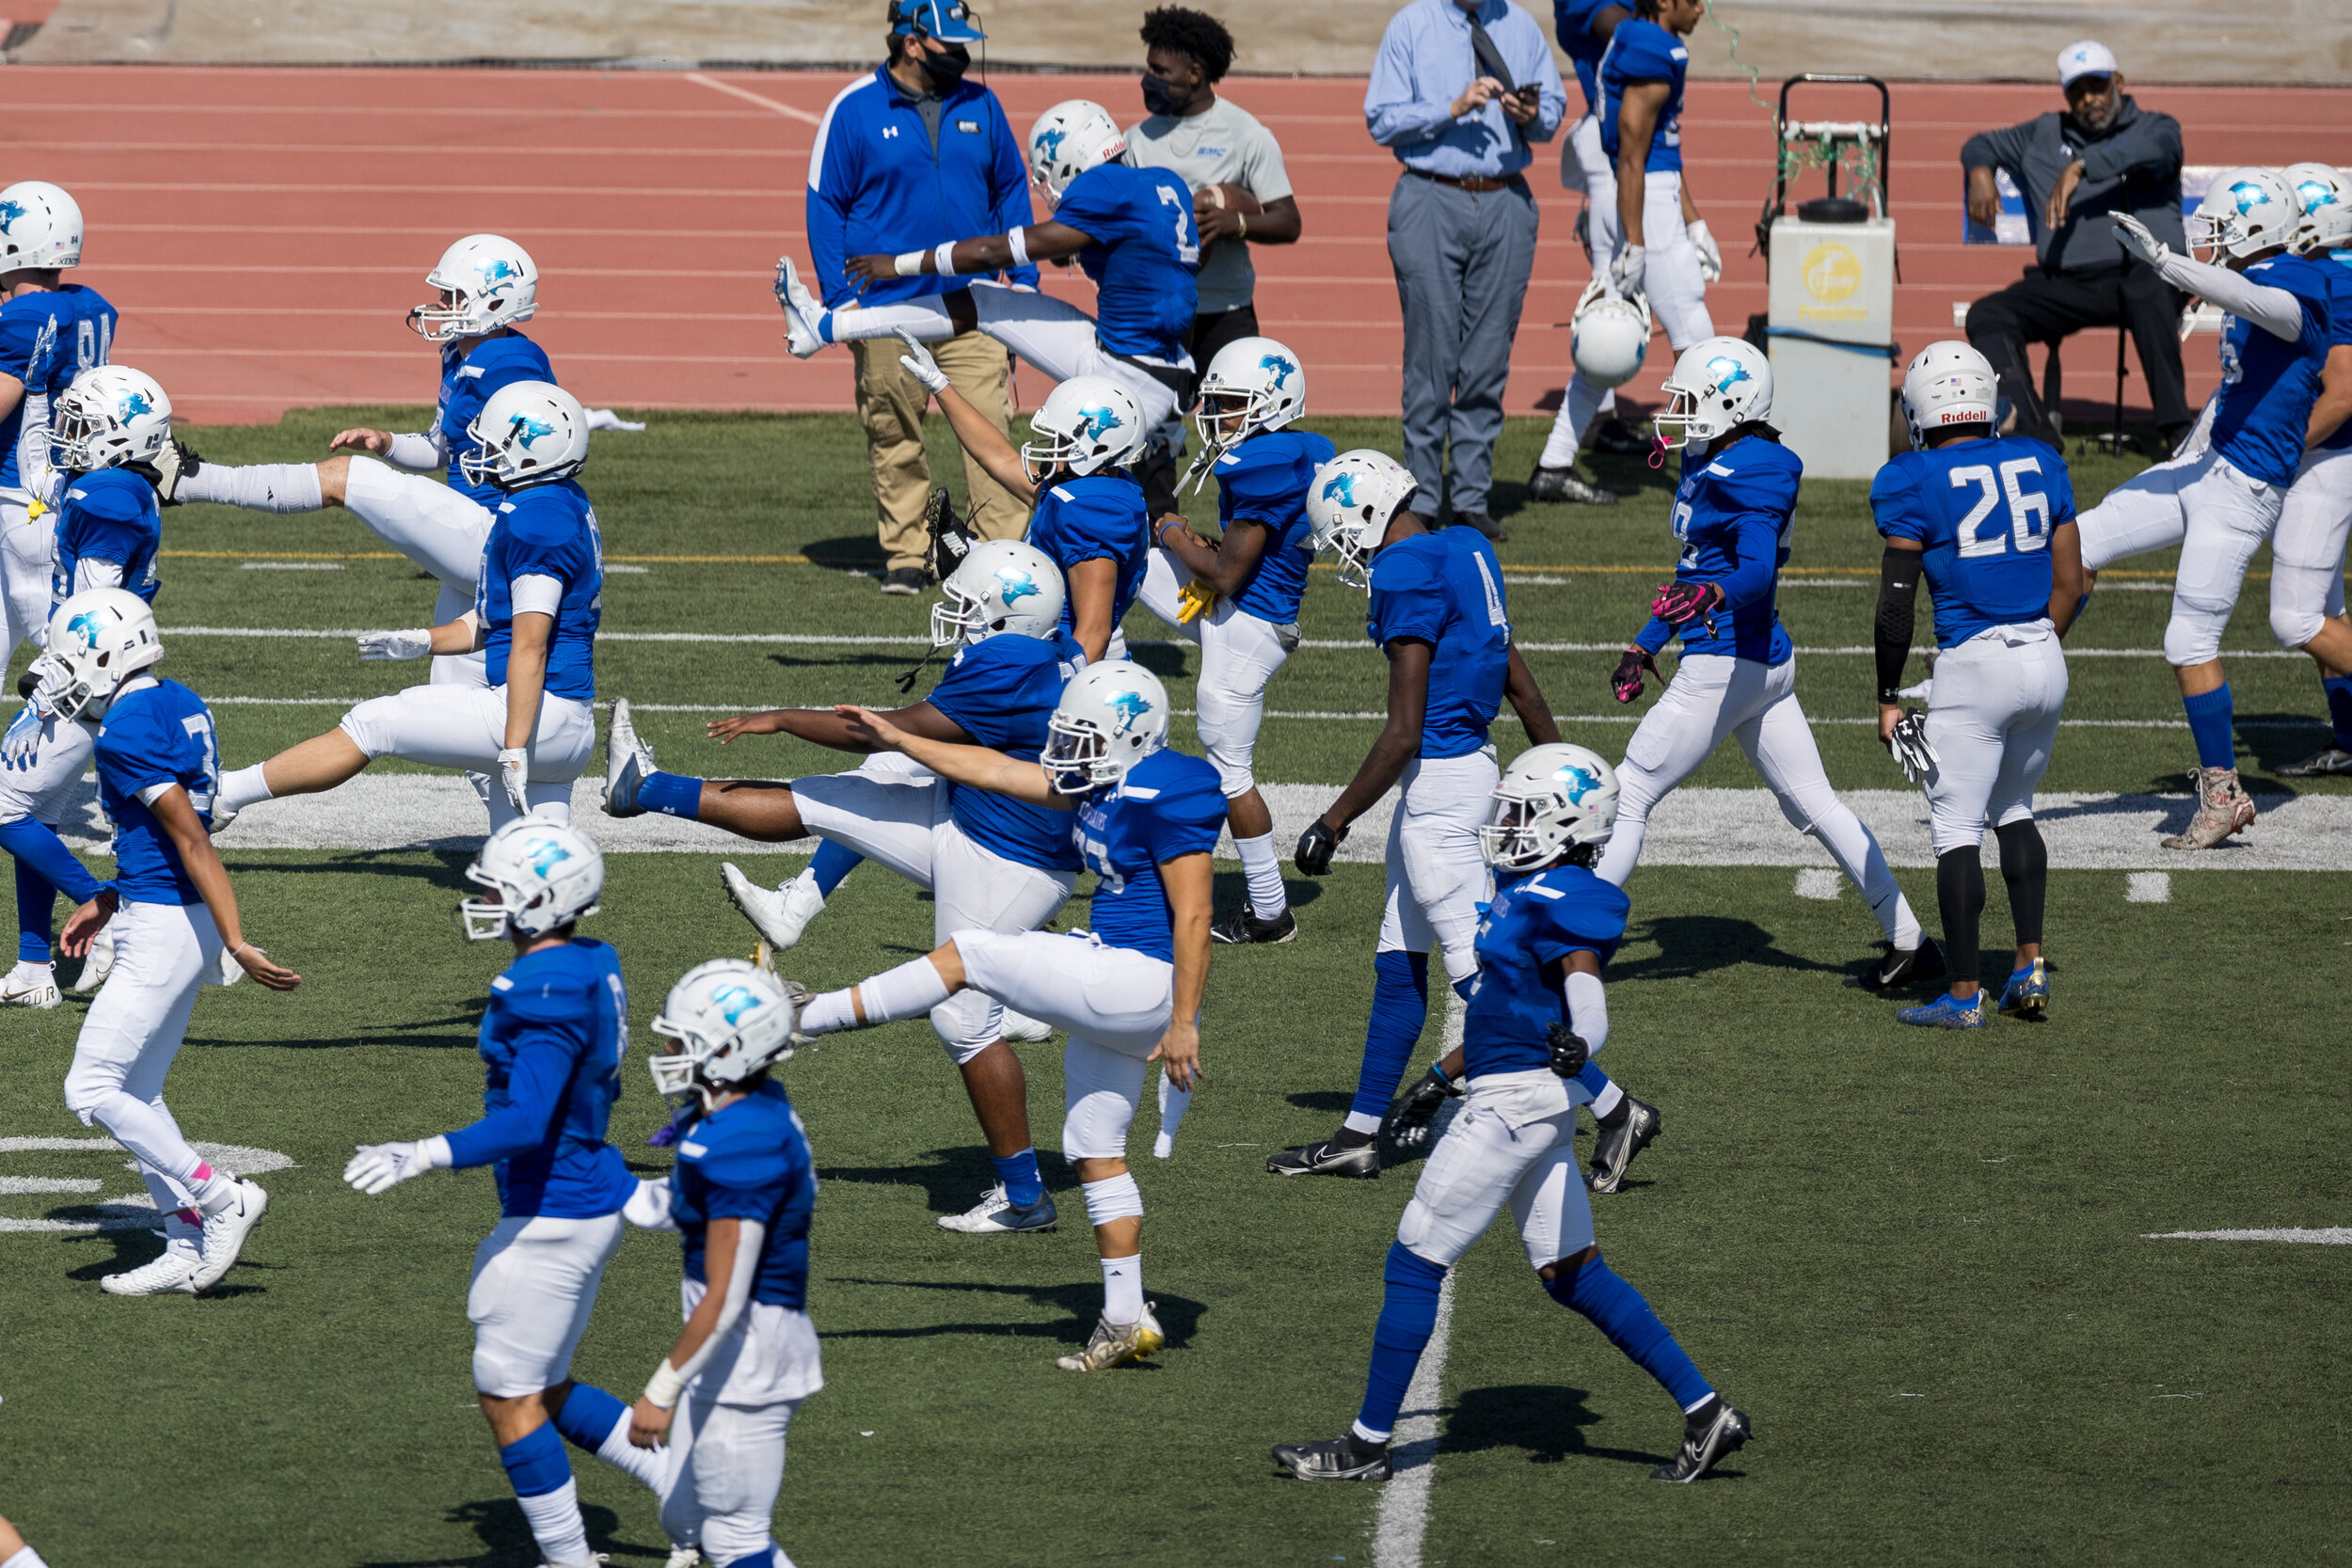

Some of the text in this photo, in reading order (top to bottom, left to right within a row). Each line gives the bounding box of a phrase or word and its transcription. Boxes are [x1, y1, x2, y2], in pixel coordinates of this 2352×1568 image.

[1155, 184, 1200, 262] 2
[1941, 410, 1987, 423] Riddell
[941, 531, 968, 558] NIKE
[1948, 456, 2049, 558] 26
[1472, 550, 1509, 646] 4
